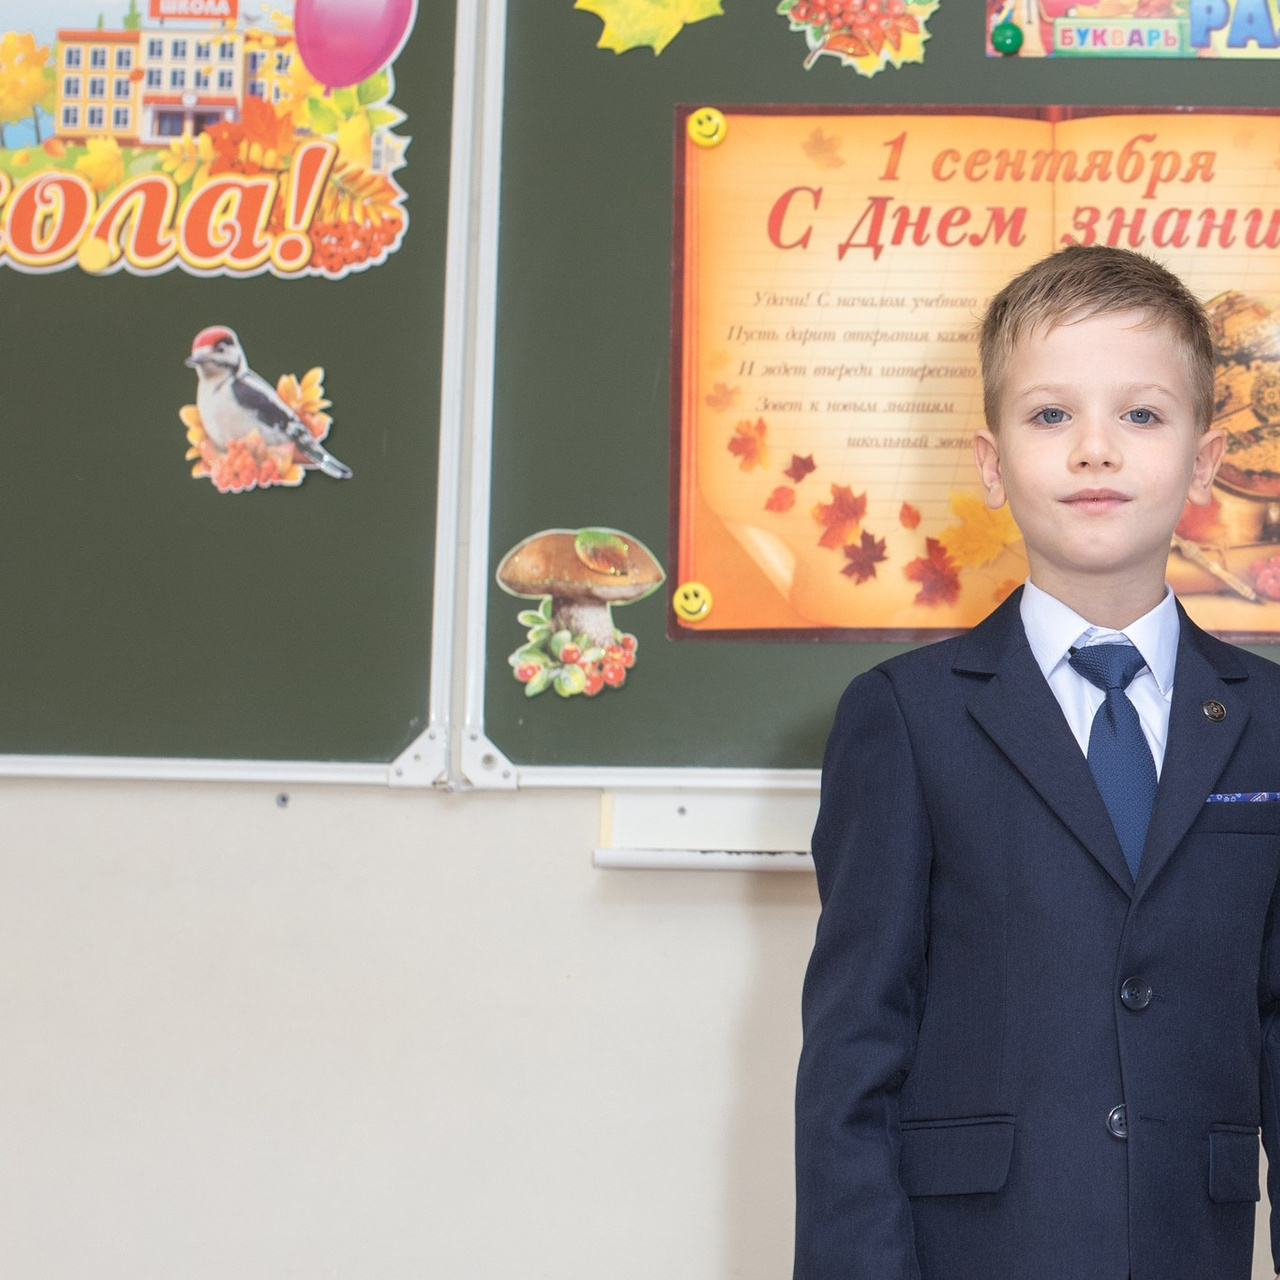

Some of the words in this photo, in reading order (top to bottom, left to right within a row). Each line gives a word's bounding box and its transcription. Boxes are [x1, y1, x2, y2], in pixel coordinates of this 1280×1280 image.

[1060, 30, 1178, 49] БУКВАРЬ
[877, 131, 909, 182] 1
[931, 134, 1217, 199] сентября
[0, 143, 337, 264] ола!
[767, 185, 824, 250] С
[838, 195, 1028, 261] Днем
[753, 291, 810, 308] Удачи!
[836, 296, 906, 308] началом
[910, 293, 977, 314] учебного
[727, 325, 779, 346] Пусть
[785, 326, 836, 347] дарит
[842, 328, 930, 347] открытия
[739, 361, 755, 377] И
[813, 363, 874, 382] впереди
[880, 363, 978, 383] интересного
